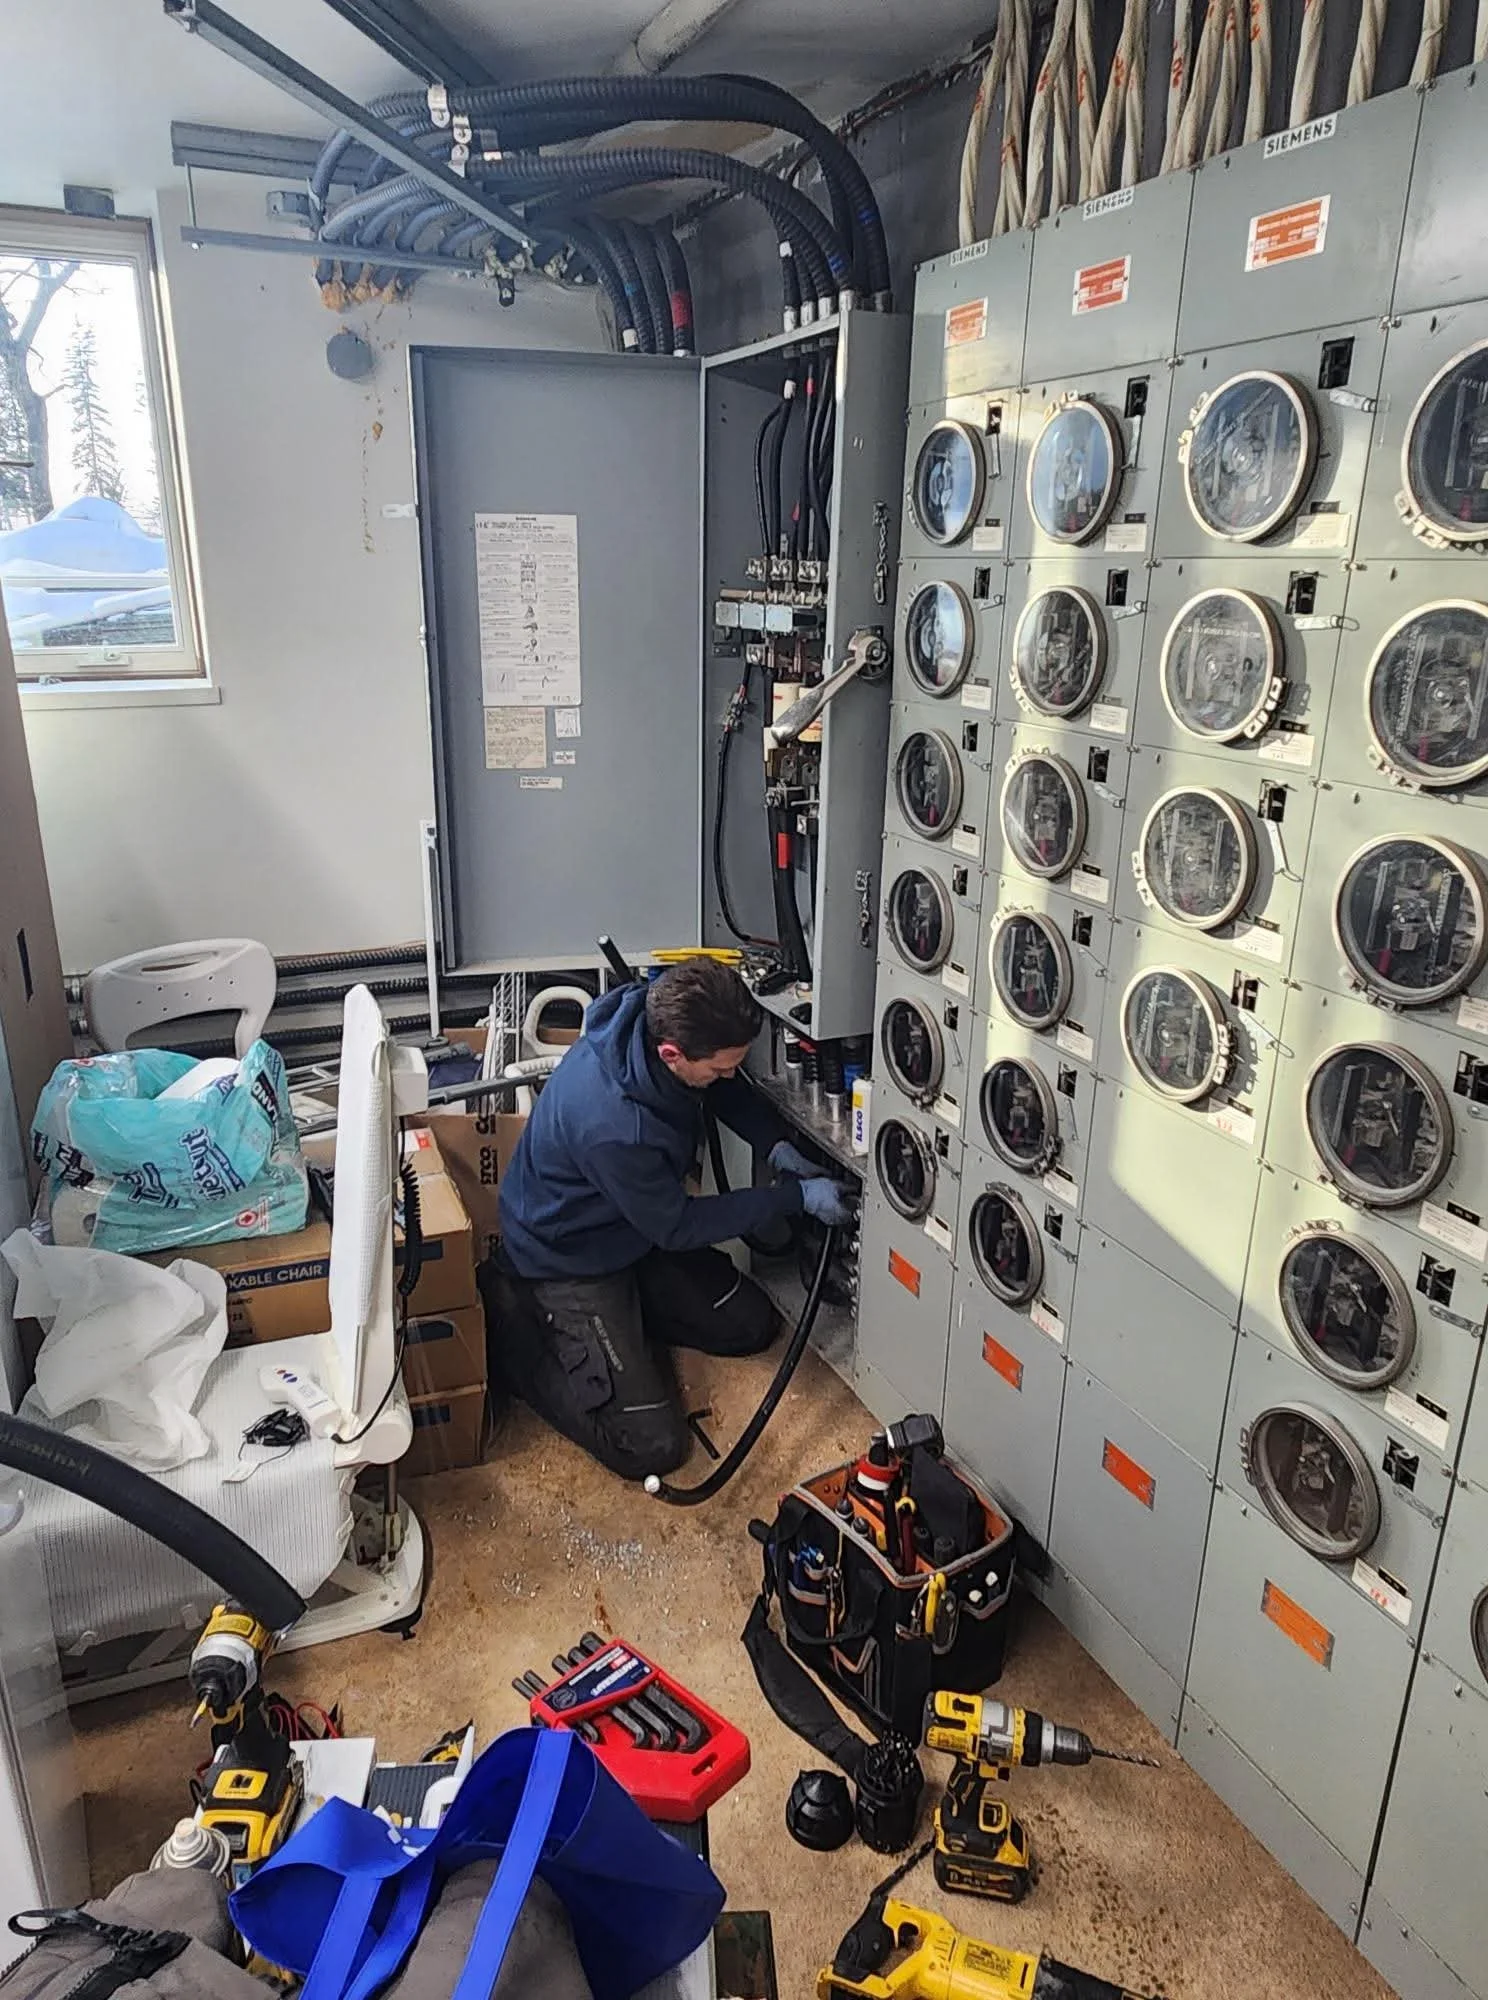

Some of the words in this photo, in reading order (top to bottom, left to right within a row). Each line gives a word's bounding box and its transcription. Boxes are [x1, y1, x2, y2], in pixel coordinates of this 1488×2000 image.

[1266, 119, 1333, 155] SIEMENS
[1086, 189, 1132, 217] SIEMENS
[951, 242, 986, 264] SIEMENS
[228, 1272, 272, 1289] KABLE
[277, 1264, 323, 1282] CHAIR
